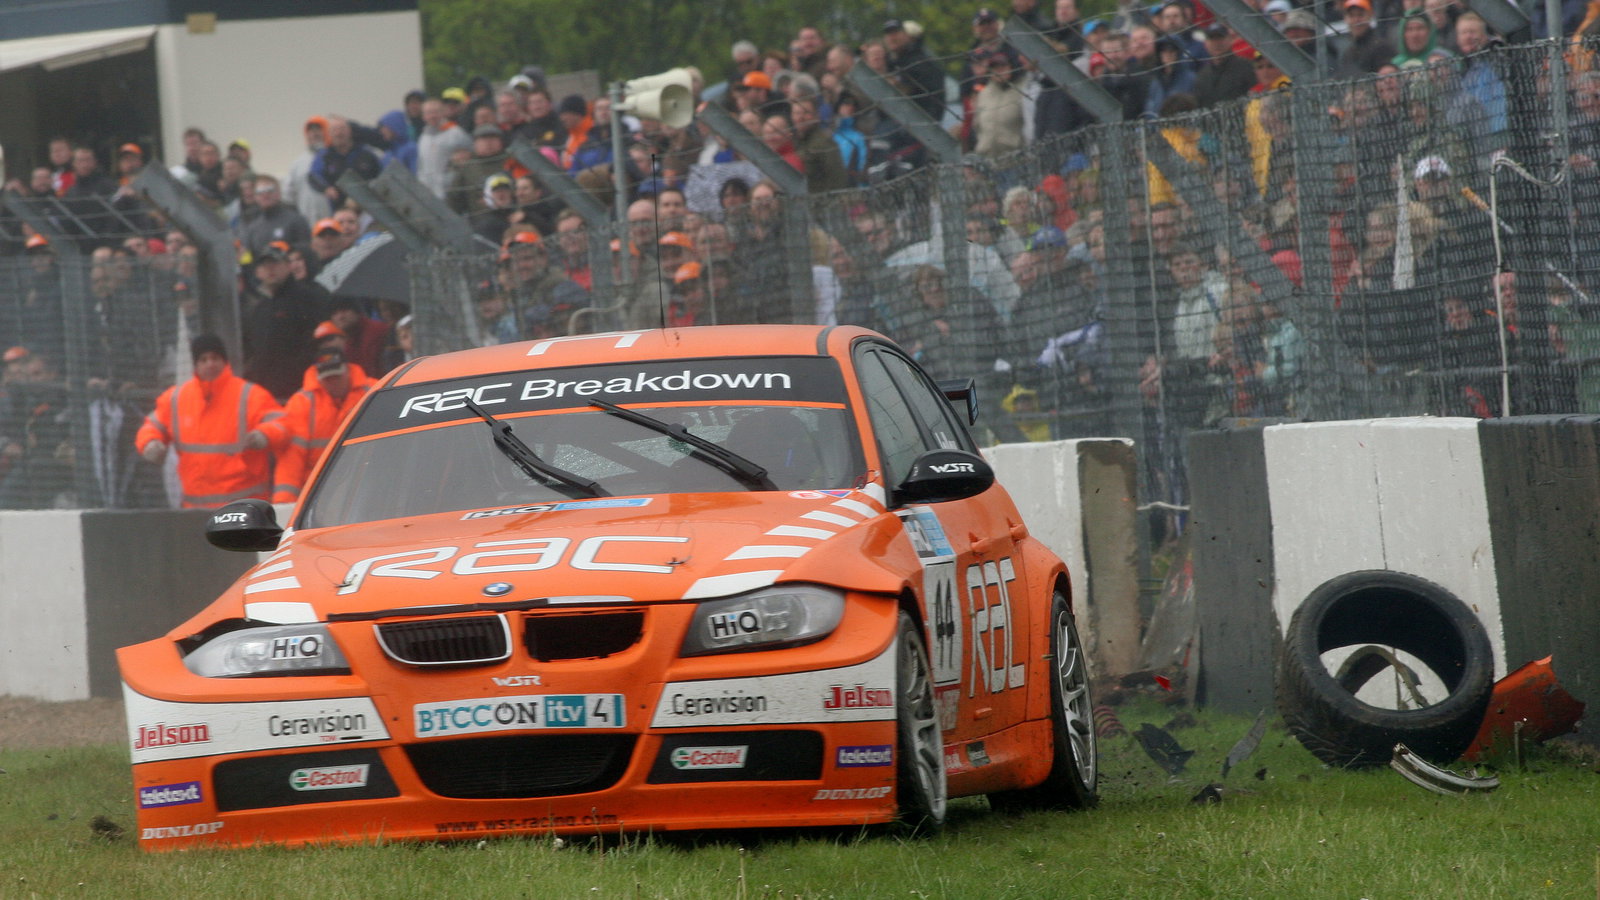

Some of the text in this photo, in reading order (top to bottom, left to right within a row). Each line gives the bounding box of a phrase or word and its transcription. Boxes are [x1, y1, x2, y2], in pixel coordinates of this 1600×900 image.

[520, 370, 791, 400] Breakdown
[929, 463, 975, 473] WSR
[214, 513, 247, 524] WSR
[711, 611, 760, 638] HiQ
[935, 578, 955, 668] 44
[273, 636, 319, 658] HiQ
[491, 675, 542, 687] WSR
[546, 701, 584, 722] itv
[592, 698, 608, 722] 4
[671, 689, 767, 715] Ceravision
[269, 708, 366, 737] Ceravision
[134, 722, 213, 751] Jelson
[689, 749, 742, 766] Castrol
[839, 748, 892, 764] teletext
[309, 768, 364, 787] Castrol
[141, 784, 200, 805] teletext
[812, 786, 892, 801] DUNLOP
[141, 821, 225, 840] DUNLOP
